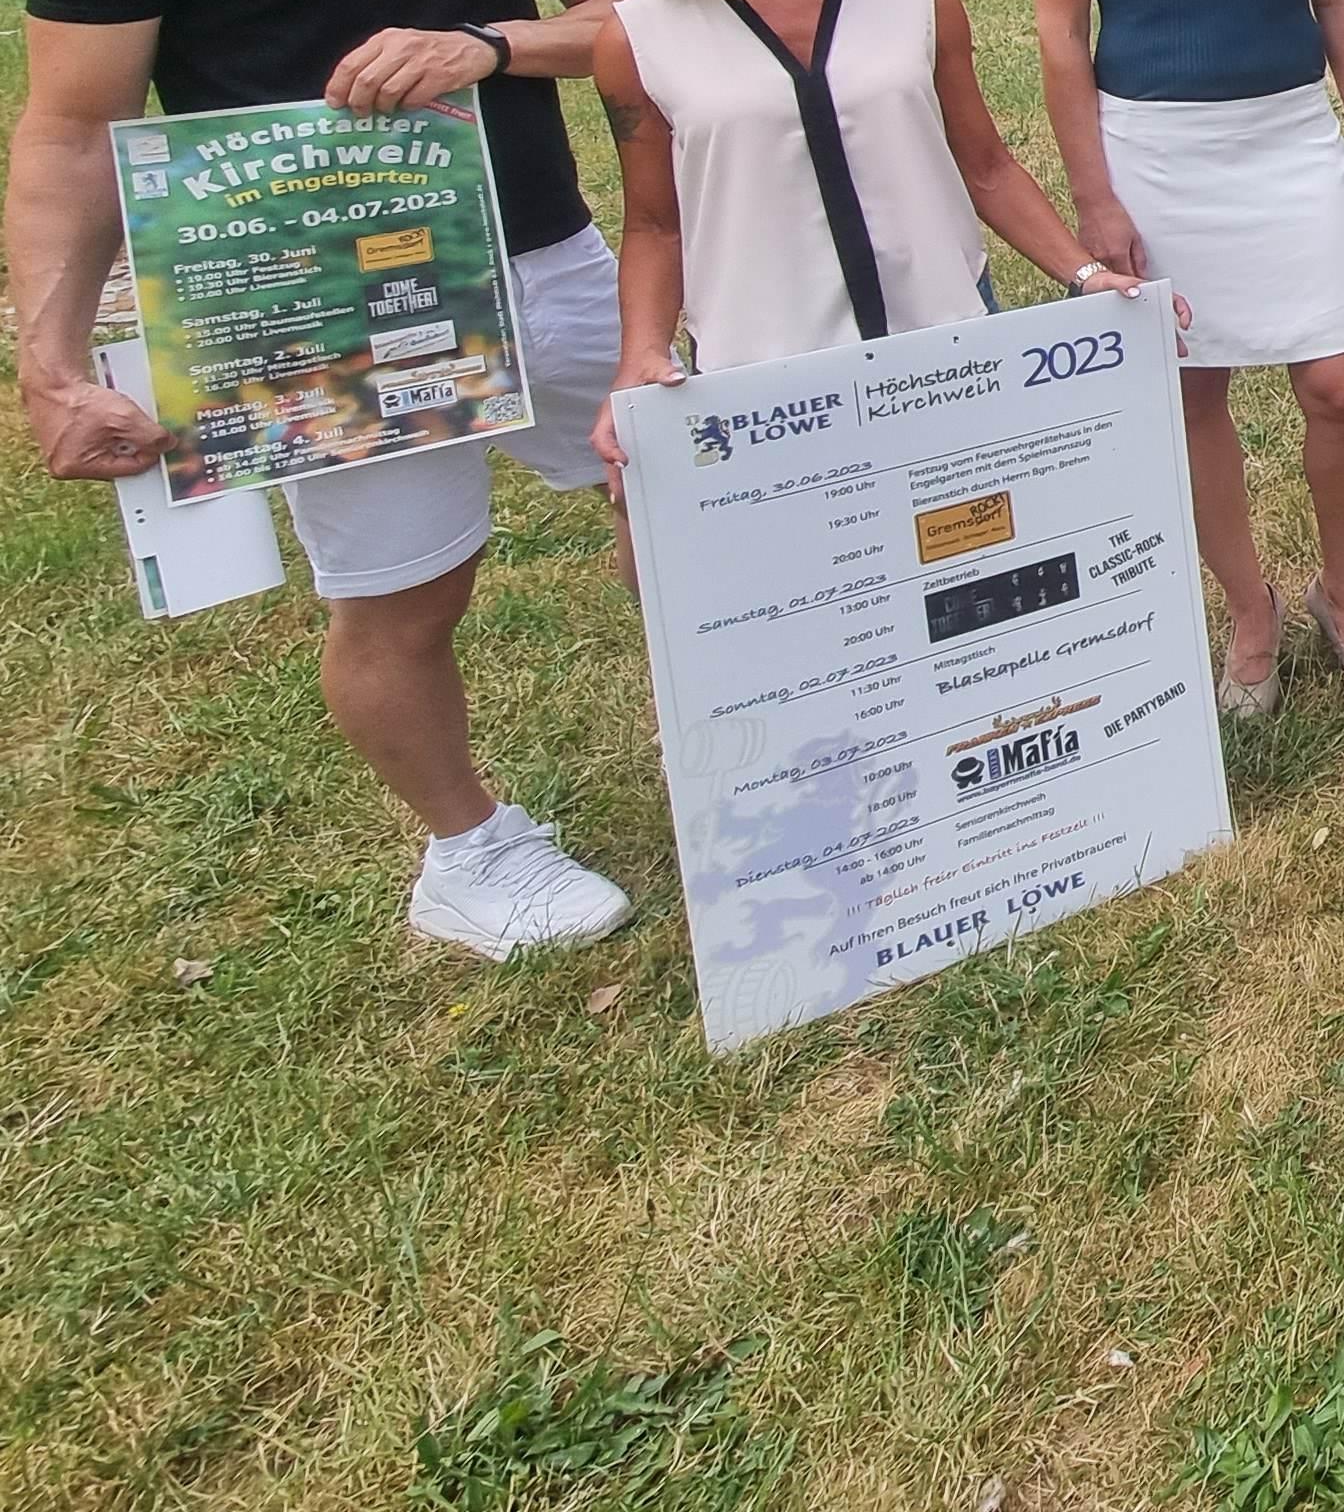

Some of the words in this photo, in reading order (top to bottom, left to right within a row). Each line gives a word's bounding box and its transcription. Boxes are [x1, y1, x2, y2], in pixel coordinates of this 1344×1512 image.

[196, 116, 430, 162] Höchstadter
[182, 140, 452, 200] Kirchweih
[224, 188, 262, 209] im
[270, 170, 428, 196] Engelgarten
[177, 217, 277, 244] 30.06.
[302, 189, 458, 227] 04.07.2023
[173, 258, 242, 275] Freitag,
[248, 252, 276, 263] 30.
[277, 245, 317, 260] Juni
[367, 286, 440, 319] TOGETHER!
[382, 278, 419, 298] COME
[181, 308, 265, 329] Samstag,
[272, 304, 288, 314] 1.
[292, 297, 322, 311] Juli
[189, 356, 269, 377] Sonntag,
[273, 350, 292, 360] 2.
[295, 342, 326, 357] Juli
[1021, 330, 1125, 388] 2023
[866, 358, 1003, 400] Höchstadter
[196, 400, 268, 421] Montag,
[295, 387, 325, 401] Juli
[731, 393, 844, 431] BLAUER
[867, 378, 1001, 422] Kirchweih
[204, 440, 288, 465] Dienstag,
[293, 434, 310, 446] 4.
[315, 427, 344, 442] Juli
[750, 414, 832, 445] LÖWE
[908, 462, 948, 479] Festzug
[950, 456, 974, 468] vom
[976, 428, 1082, 462] Feuerwehrgerätehaus
[1084, 425, 1092, 433] in
[1094, 420, 1113, 431] den
[910, 470, 972, 491] Engelgarten
[975, 462, 992, 474] mit
[994, 456, 1017, 469] dem
[1018, 437, 1092, 464] Spielmannszug
[824, 484, 854, 500] 19:00
[856, 480, 876, 496] Uhr
[912, 488, 968, 508] Bieranstich
[970, 478, 1000, 493] durch
[1002, 470, 1030, 486] Herrn
[1032, 463, 1058, 480] Bgm.
[1058, 454, 1090, 468] Brehm
[700, 487, 767, 512] Freitag,
[828, 514, 857, 530] 19:30
[860, 509, 880, 524] Uhr
[832, 550, 862, 566] 20:00
[864, 544, 884, 558] Uhr
[1088, 532, 1166, 579] CLASSIC-ROCK
[1108, 529, 1132, 548] THE
[923, 568, 980, 591] Zeltbetrieb
[1111, 556, 1158, 587] TRIBUTE
[840, 600, 869, 616] 13:00
[871, 594, 891, 608] Uhr
[843, 630, 873, 647] 20:00
[875, 624, 896, 639] Uhr
[934, 646, 996, 672] Mittagstisch
[936, 648, 1051, 695] Blaskapelle
[1056, 611, 1156, 657] Gremsdorf
[881, 675, 902, 687] Uhr
[709, 687, 795, 719] Sonntag,
[854, 705, 883, 721] 16:00
[885, 698, 905, 711] Uhr
[1103, 723, 1124, 739] DIE
[1123, 682, 1187, 728] PARTYBAND
[733, 768, 806, 796] Montag,
[863, 767, 892, 784] 10:00
[894, 759, 913, 773] Uhr
[897, 790, 917, 802] Uhr
[955, 793, 1047, 832] Seniorenkirchweih
[957, 807, 1056, 848] Familiennachmittag
[735, 855, 819, 889] Dienstag,
[836, 859, 865, 875] 14:00
[874, 845, 903, 861] 16:00
[904, 837, 925, 850] Uhr
[859, 874, 874, 886] ab
[877, 862, 905, 879] 14:00
[907, 854, 927, 867] Uhr
[923, 868, 959, 891] freier
[962, 847, 1014, 874] Eintritt
[1016, 839, 1039, 854] ins
[829, 939, 855, 957] Auf
[857, 924, 895, 946] Ihren
[897, 902, 947, 930] Besuch
[949, 889, 982, 910] freut
[983, 878, 1011, 897] sich
[1012, 868, 1039, 888] Ihre
[1041, 832, 1128, 874] Privatbrauerei
[876, 909, 991, 968] BLAUER
[1006, 871, 1087, 915] LÖWE
